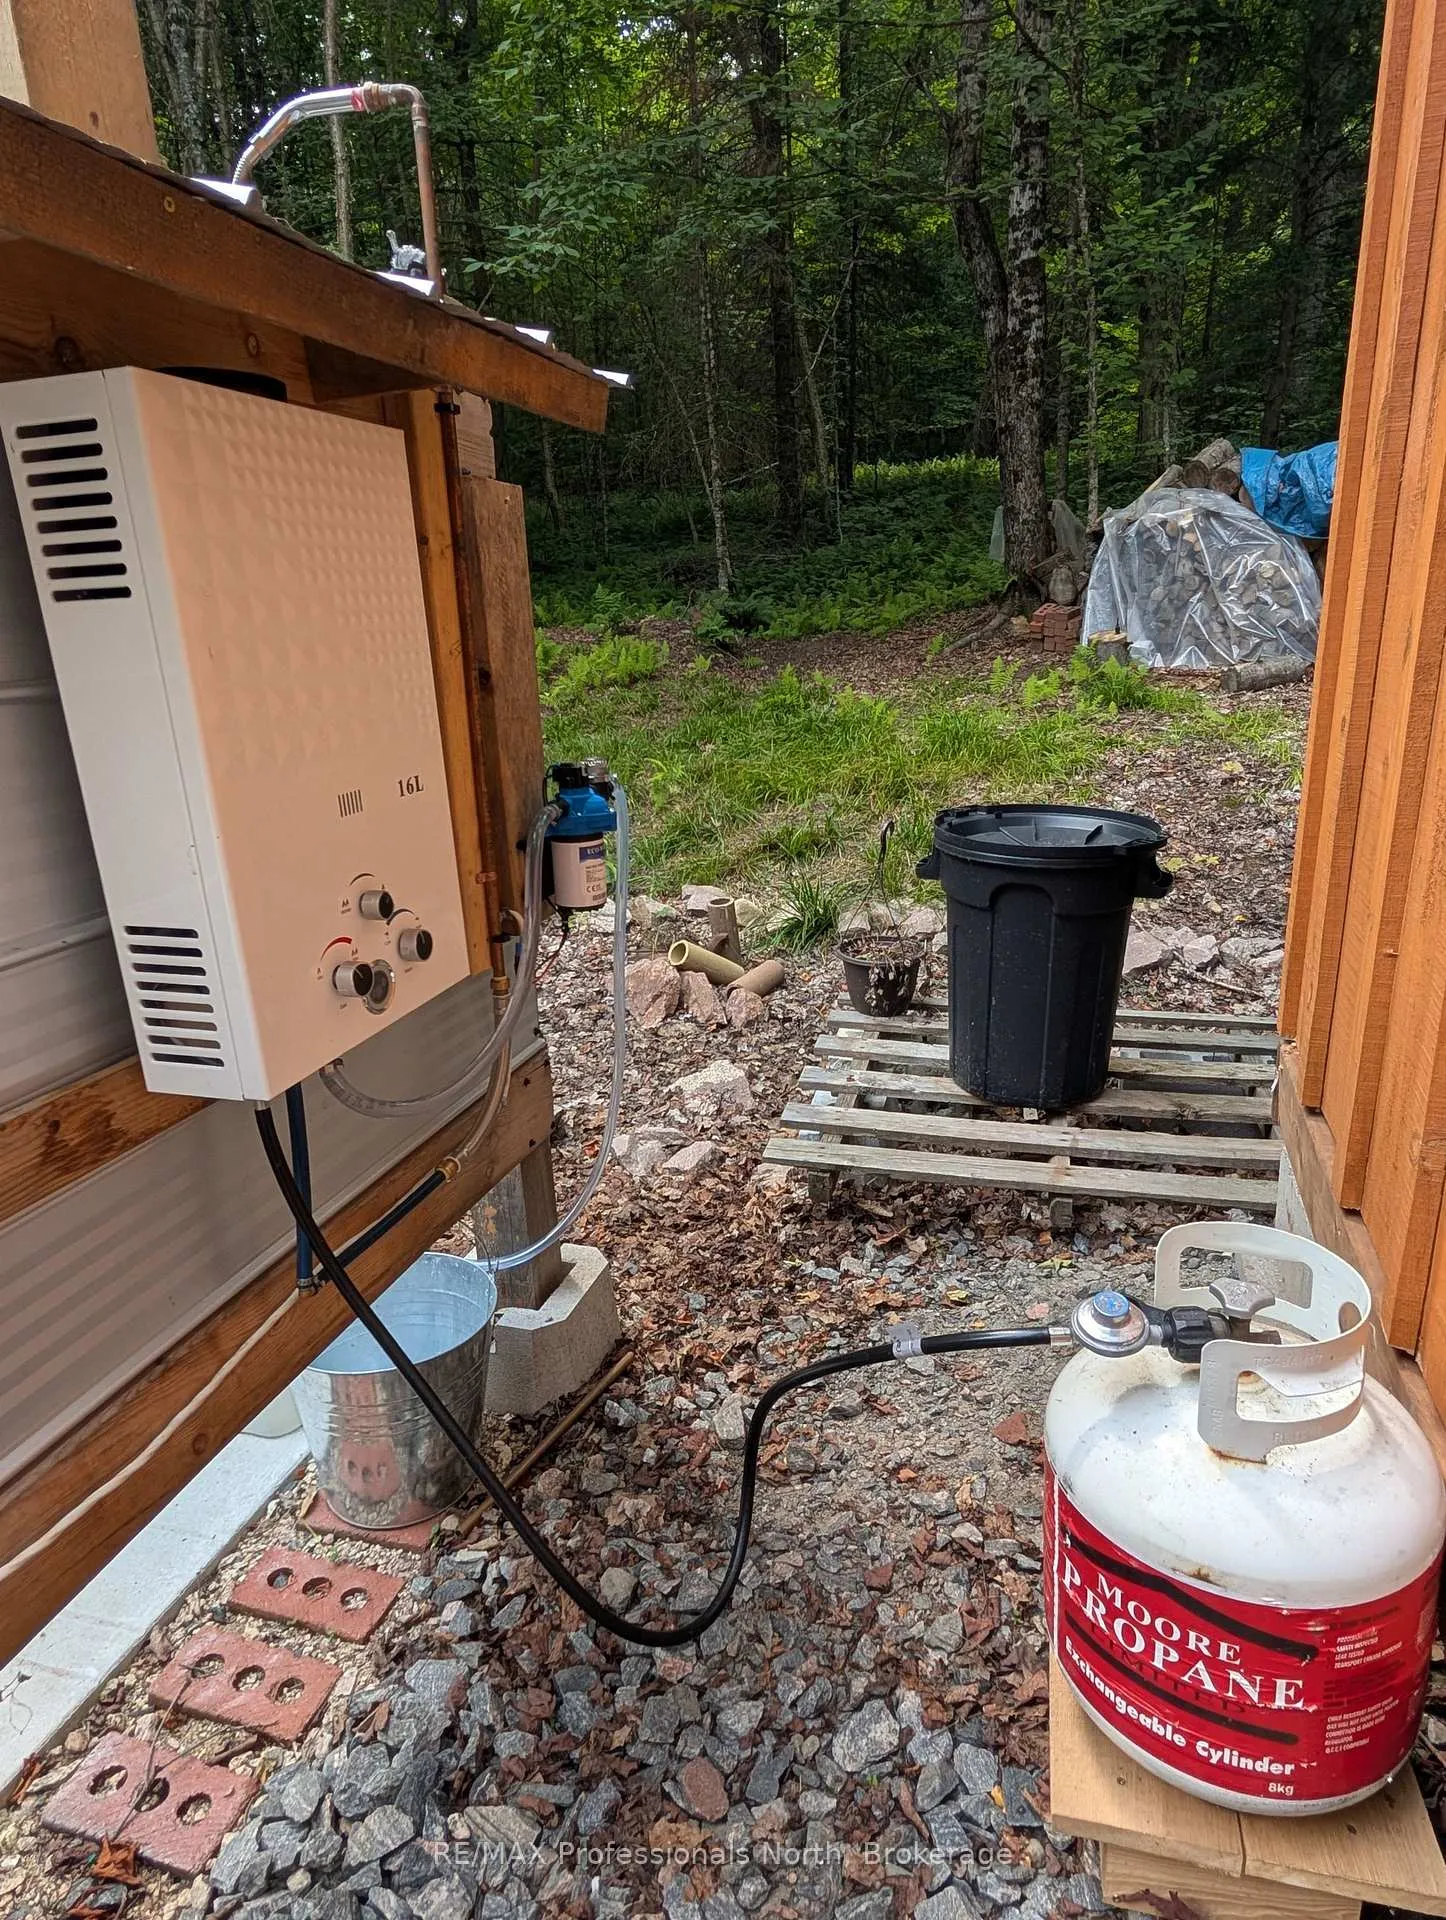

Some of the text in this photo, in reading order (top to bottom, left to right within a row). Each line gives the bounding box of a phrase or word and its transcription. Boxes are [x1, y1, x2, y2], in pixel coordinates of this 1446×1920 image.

[397, 775, 424, 798] 16L
[1062, 1552, 1307, 1711] PROPANE
[1096, 1572, 1242, 1667] MOORE
[1065, 1636, 1296, 1776] Exchangeable Cylinder
[1268, 1781, 1295, 1797] 8kg
